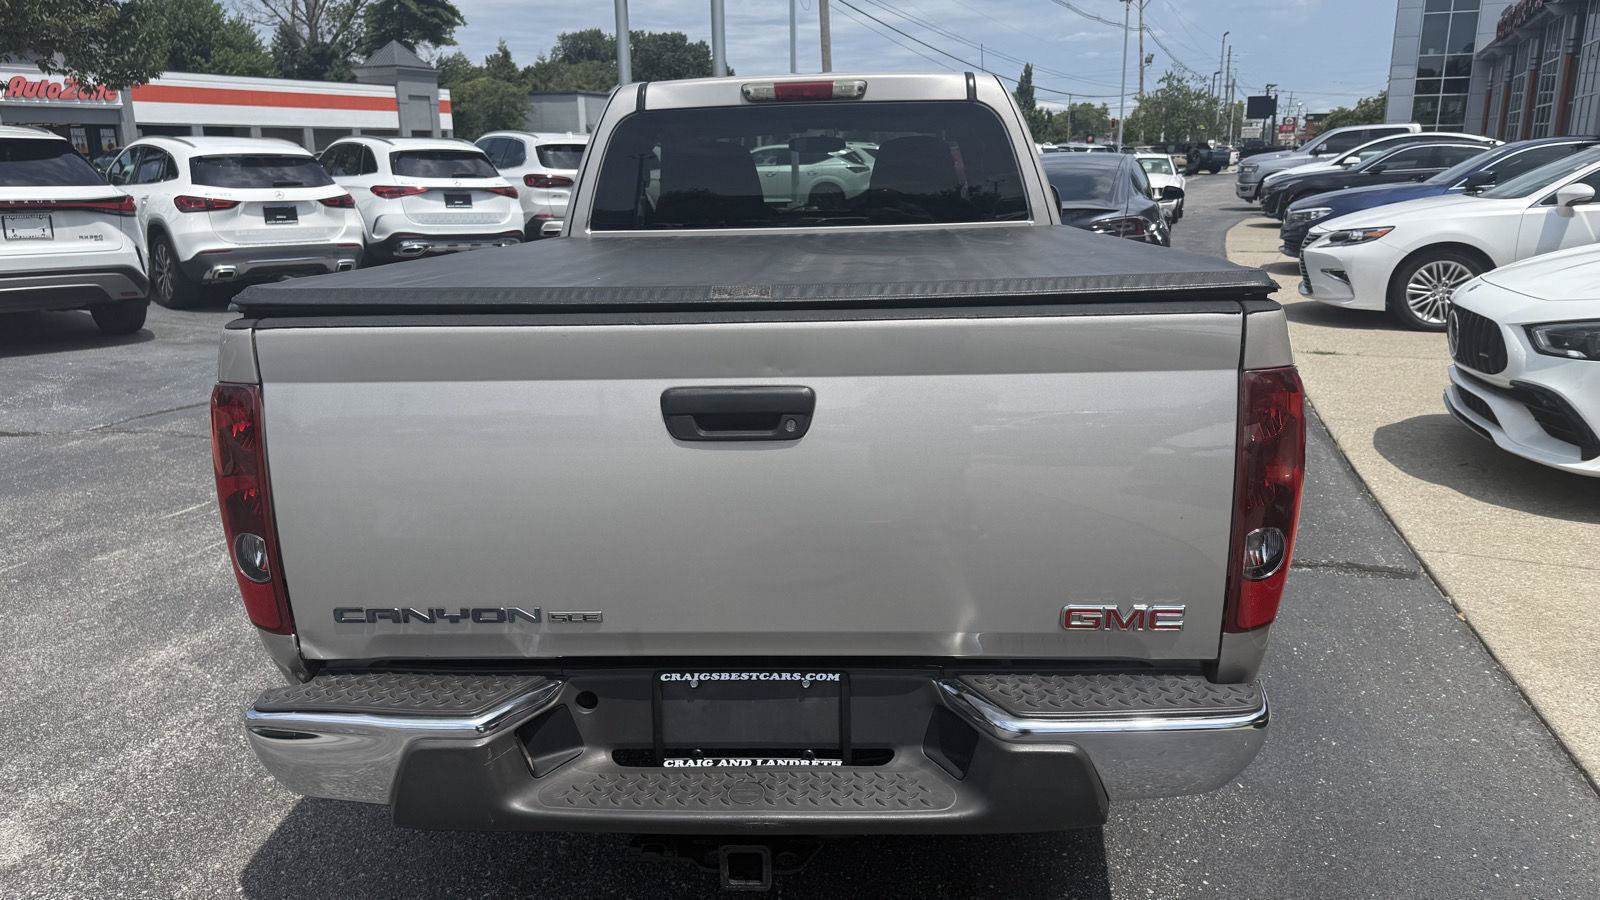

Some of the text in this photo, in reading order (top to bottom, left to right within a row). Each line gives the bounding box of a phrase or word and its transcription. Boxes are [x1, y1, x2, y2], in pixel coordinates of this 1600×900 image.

[333, 606, 601, 624] CANYON SLE
[1060, 604, 1186, 632] GMC
[660, 672, 841, 682] CRAIGSBESTCARS.COM
[663, 759, 714, 767] CRAIG
[717, 759, 752, 767] AND
